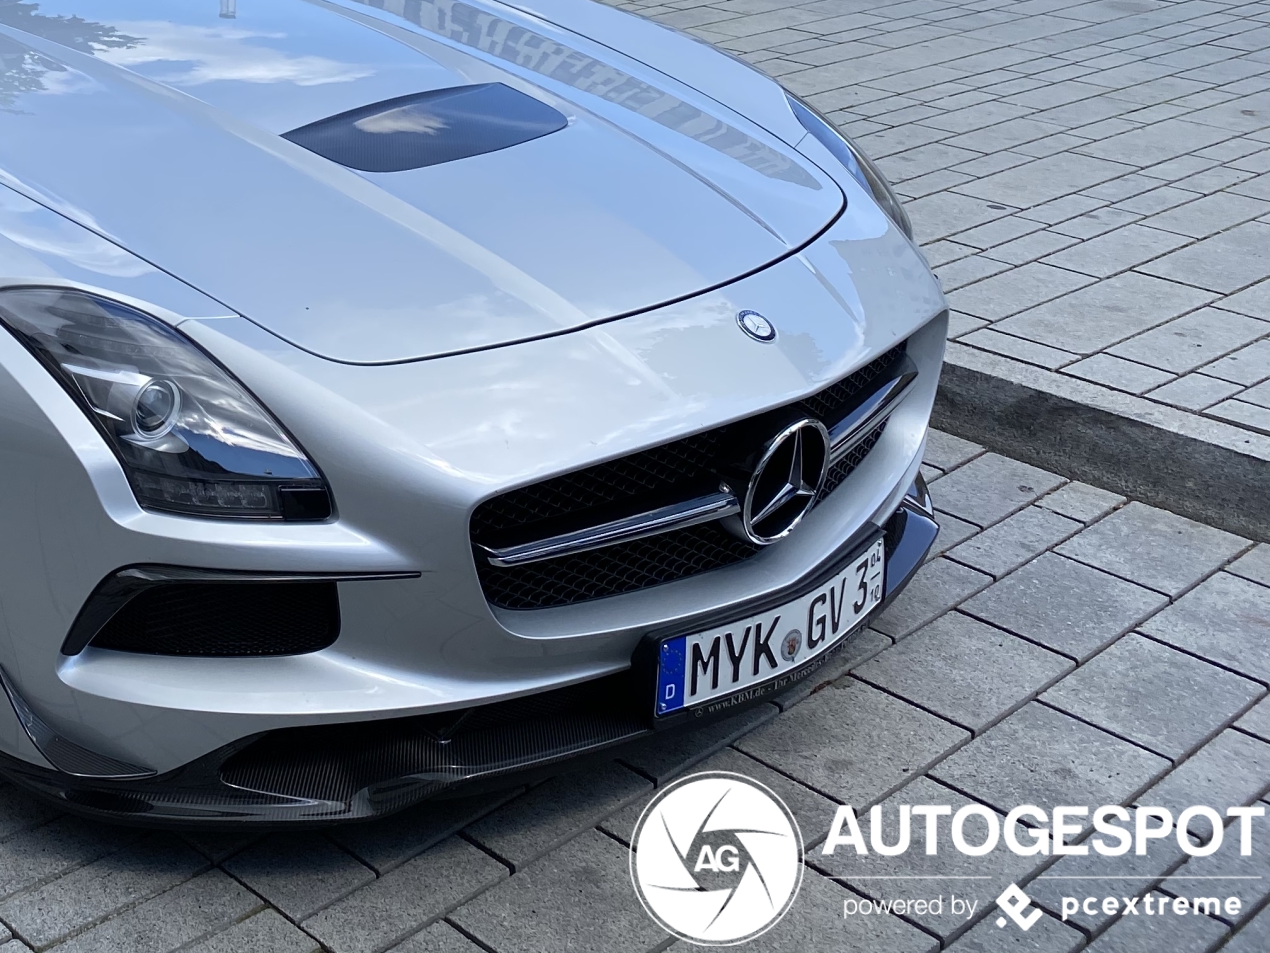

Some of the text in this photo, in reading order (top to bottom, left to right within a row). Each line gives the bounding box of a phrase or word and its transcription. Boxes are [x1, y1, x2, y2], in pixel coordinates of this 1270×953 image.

[690, 615, 781, 696] MYK
[807, 577, 847, 650] GV
[853, 557, 869, 614] 3
[665, 683, 675, 700] D
[708, 687, 766, 714] www.KBM.de
